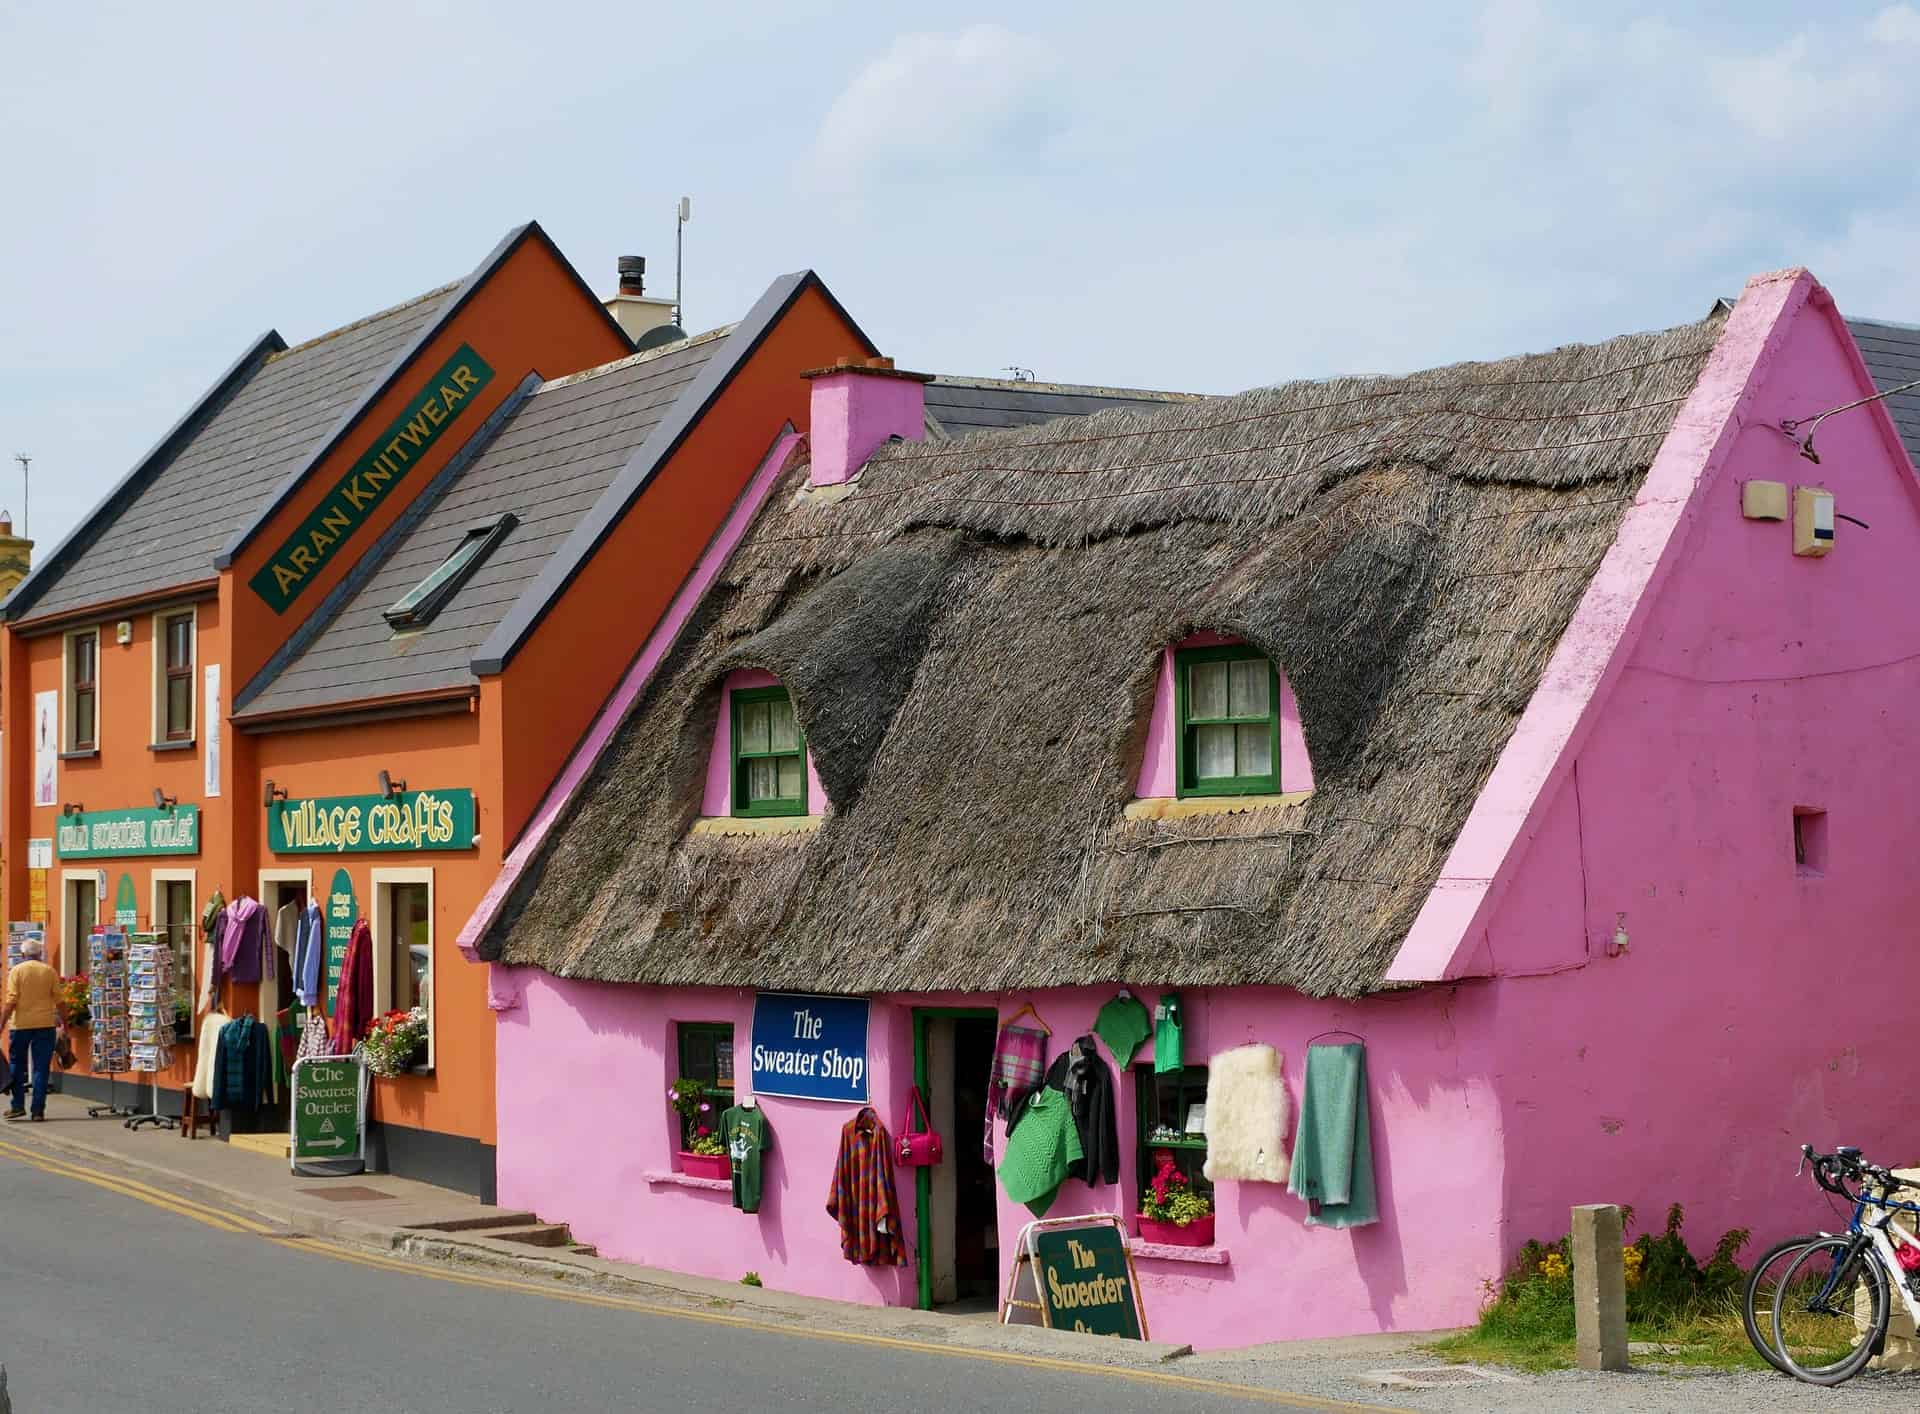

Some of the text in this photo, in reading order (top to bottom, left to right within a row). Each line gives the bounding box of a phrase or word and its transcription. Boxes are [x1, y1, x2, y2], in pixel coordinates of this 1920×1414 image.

[271, 365, 478, 596] ARAN KNITWEAR
[793, 1009, 822, 1040] The
[311, 1066, 344, 1082] The
[753, 1044, 863, 1088] Sweater Shop
[305, 1102, 352, 1115] Outlet
[1067, 1240, 1096, 1269] The
[1048, 1266, 1126, 1309] Sweater
